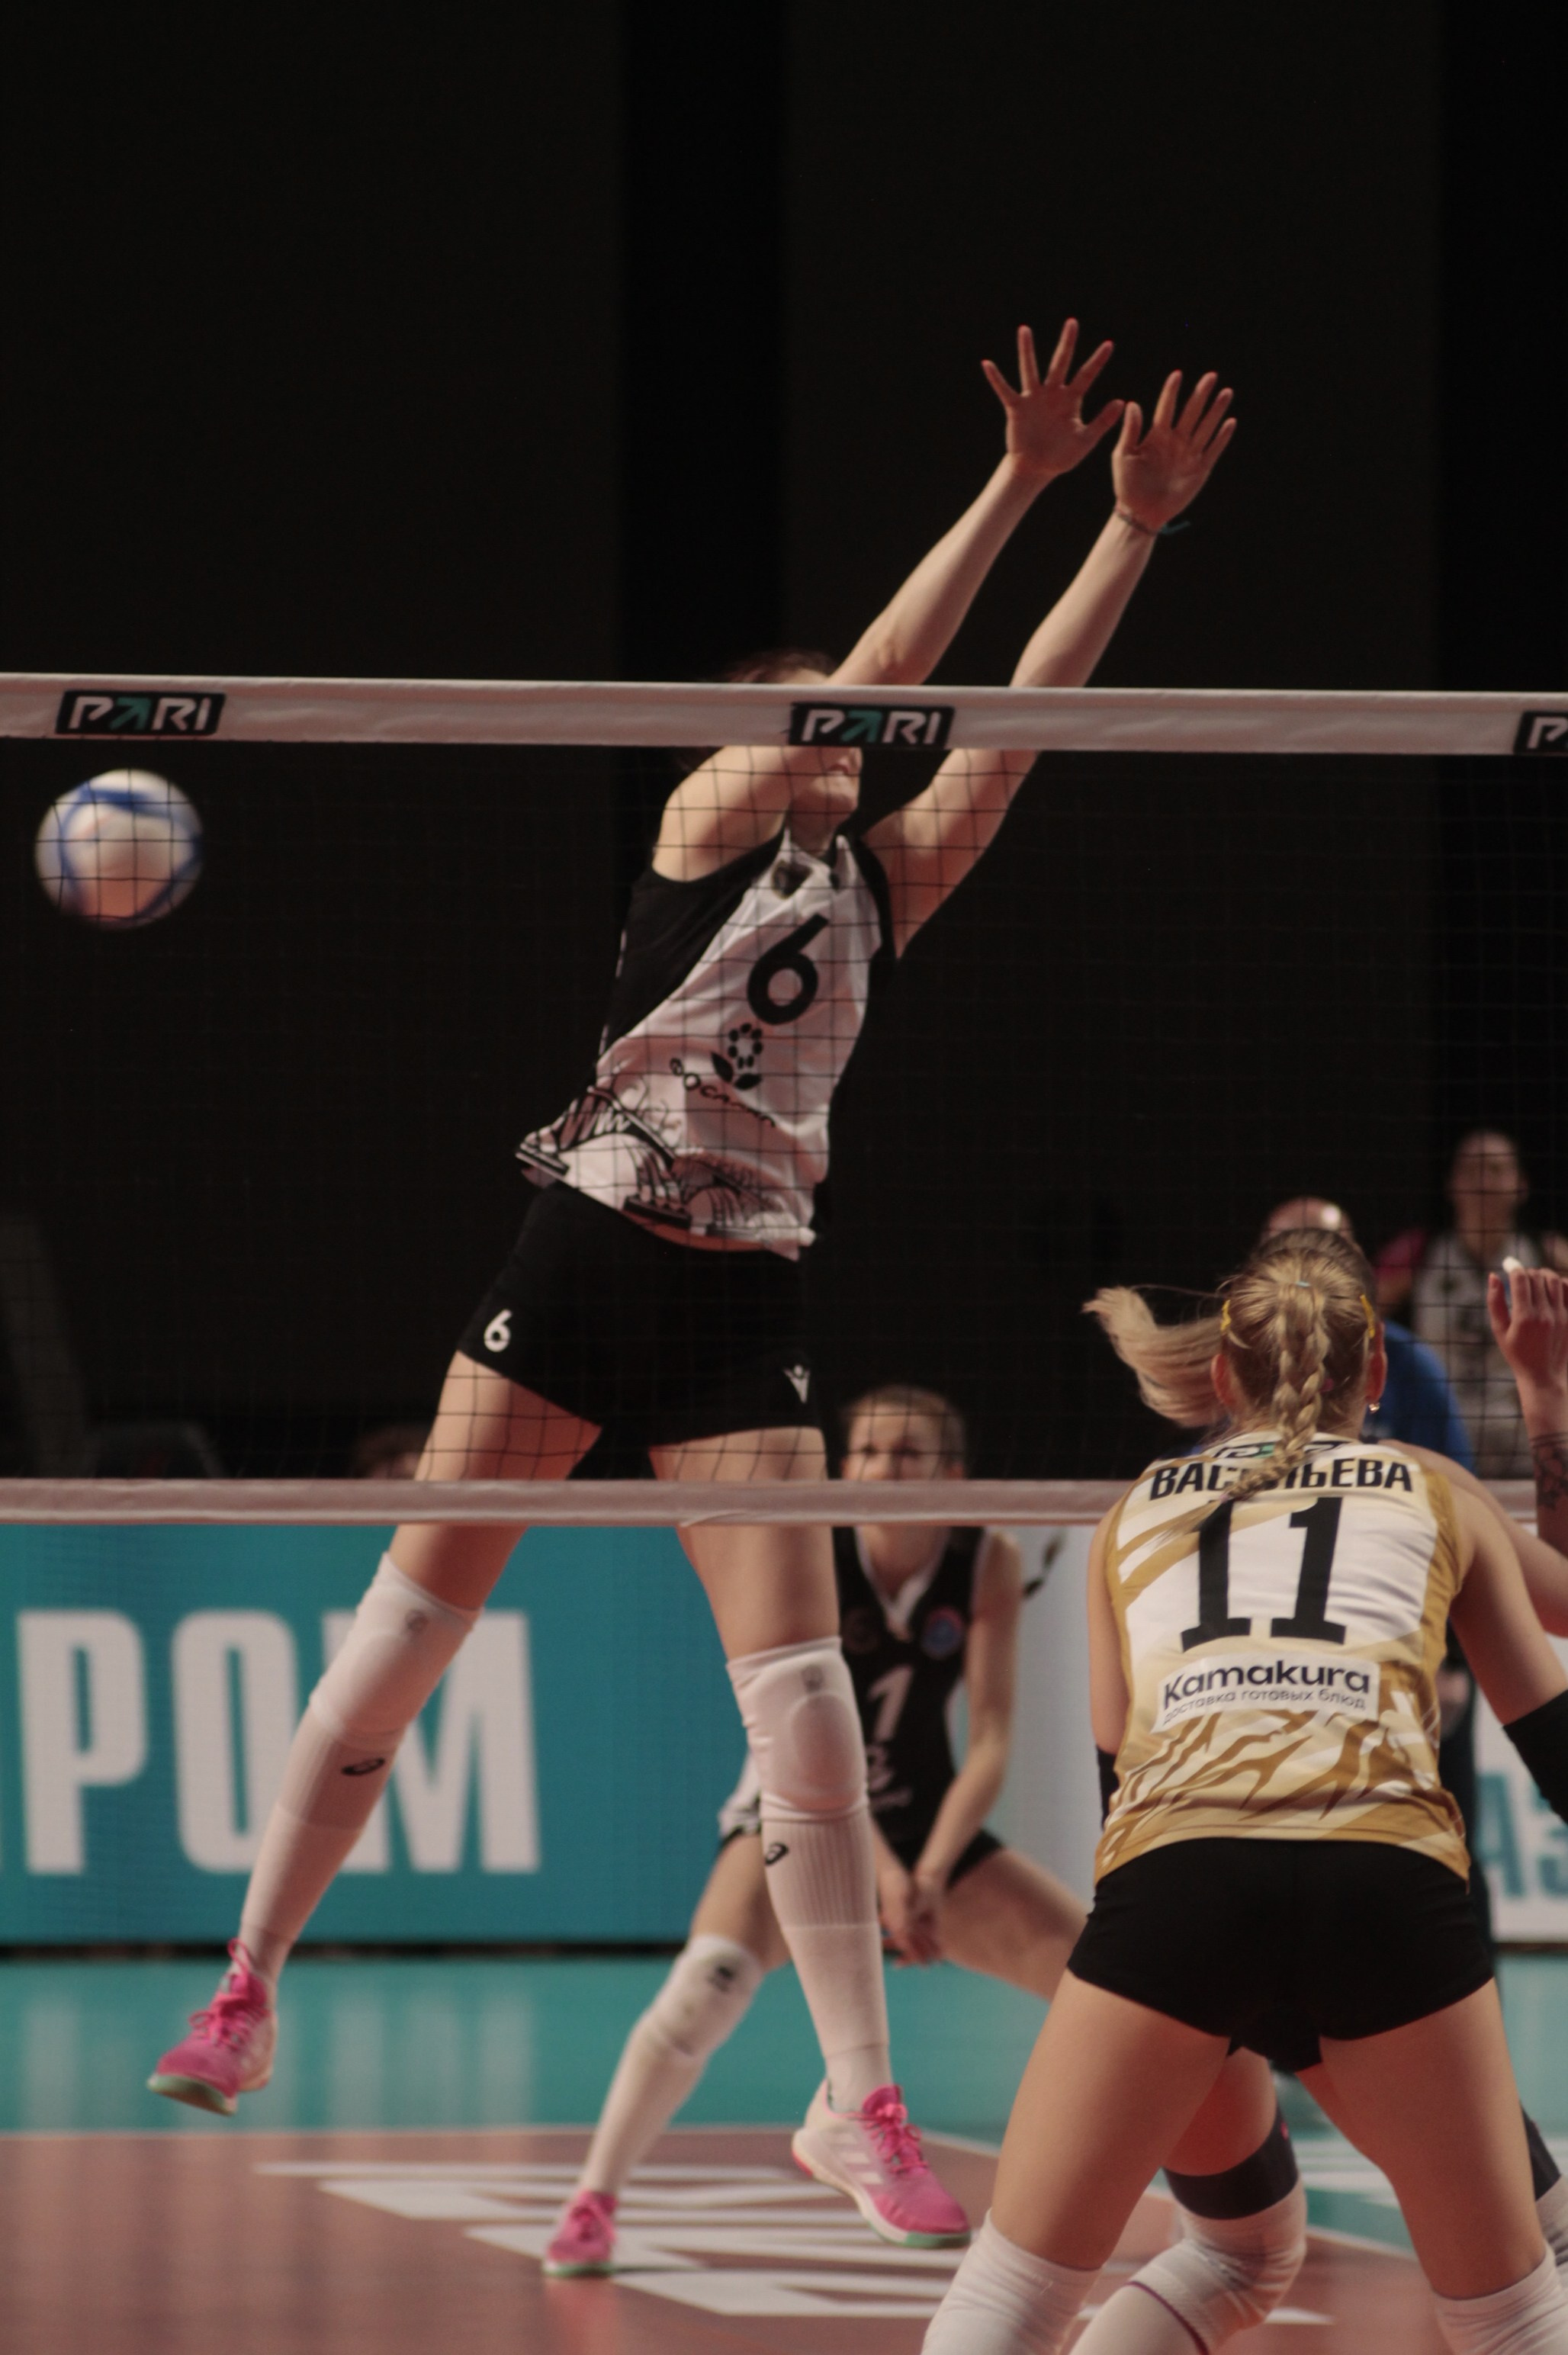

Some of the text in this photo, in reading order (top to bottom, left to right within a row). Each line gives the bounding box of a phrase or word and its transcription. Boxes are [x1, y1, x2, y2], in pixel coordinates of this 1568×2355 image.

[747, 914, 828, 1024] 6
[483, 1309, 511, 1353] 6
[1181, 1496, 1346, 1653] 11
[867, 1663, 915, 1742] 1
[1165, 1659, 1369, 1710] Kamakura
